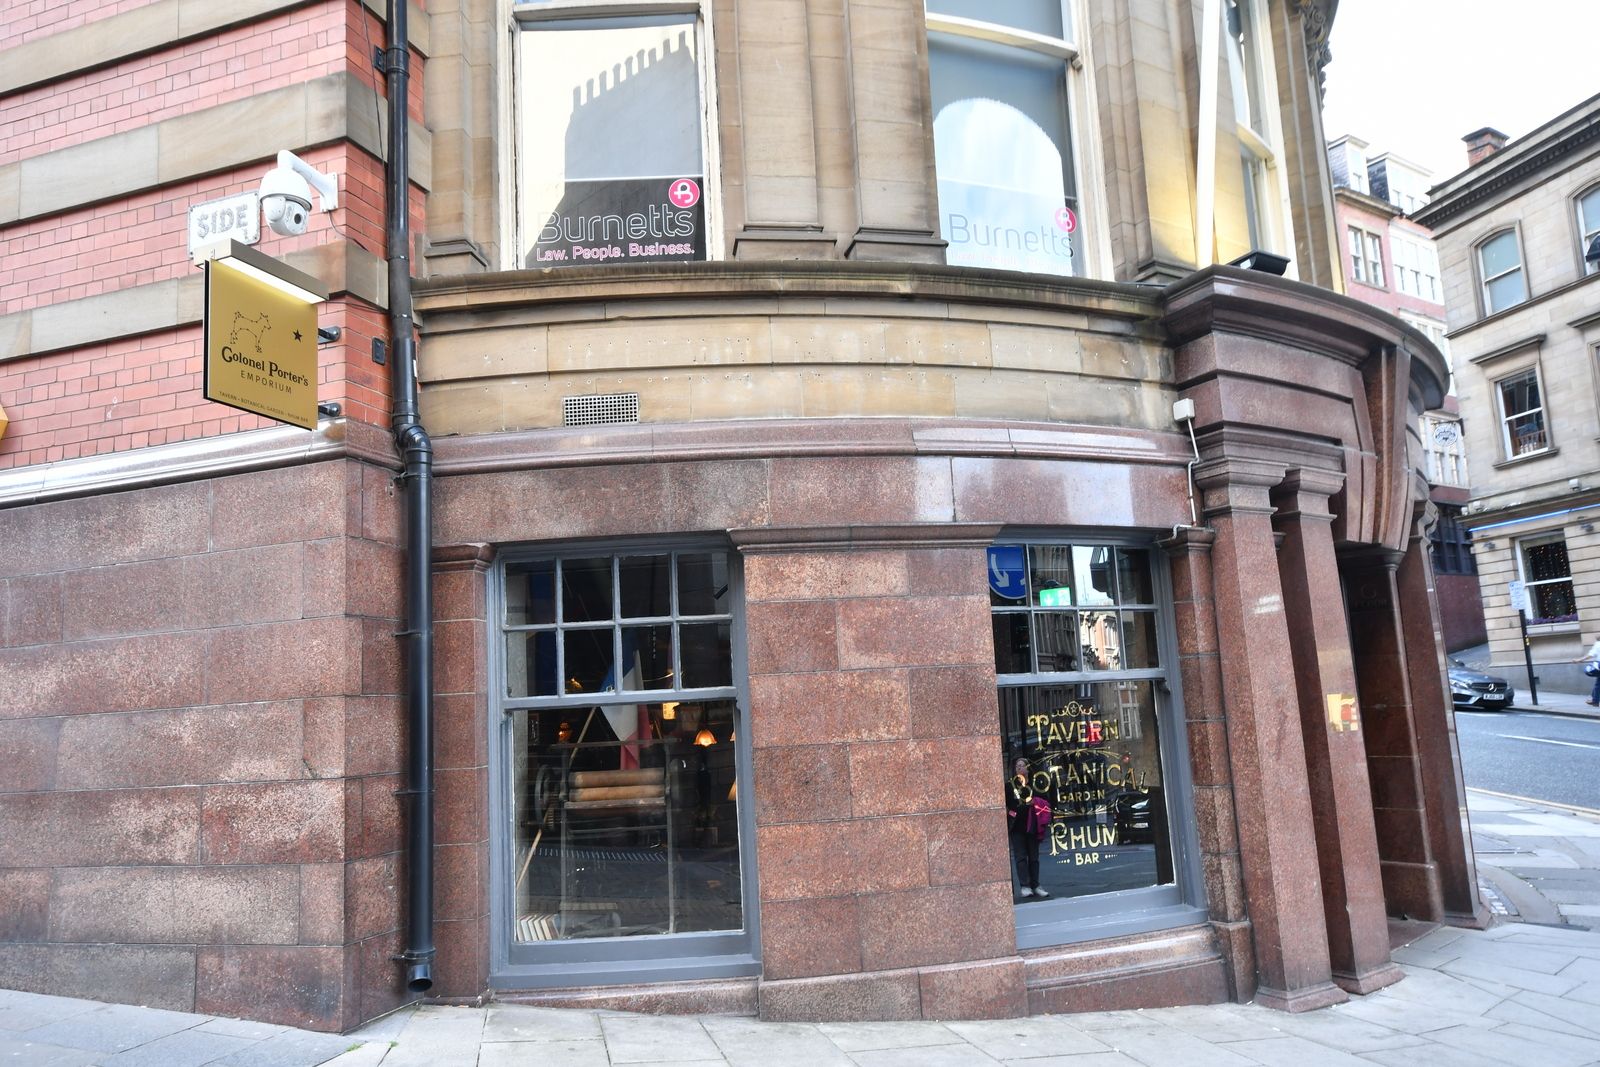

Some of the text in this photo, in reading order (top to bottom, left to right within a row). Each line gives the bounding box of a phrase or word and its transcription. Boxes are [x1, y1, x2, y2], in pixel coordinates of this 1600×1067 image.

[197, 204, 249, 239] SIDE
[536, 204, 695, 245] Burnetts
[948, 213, 1074, 258] Burnetts
[536, 241, 695, 262] Law. People. Business.
[221, 346, 309, 387] Colonel Porter's
[240, 370, 292, 394] EMPORIUM
[219, 391, 237, 401] TAVERN
[1027, 714, 1120, 750] TAVERN
[1009, 762, 1150, 804] BOTANICAL
[1060, 789, 1106, 803] GARDEN
[1049, 822, 1118, 856] RHUM
[1075, 852, 1100, 866] BAR
